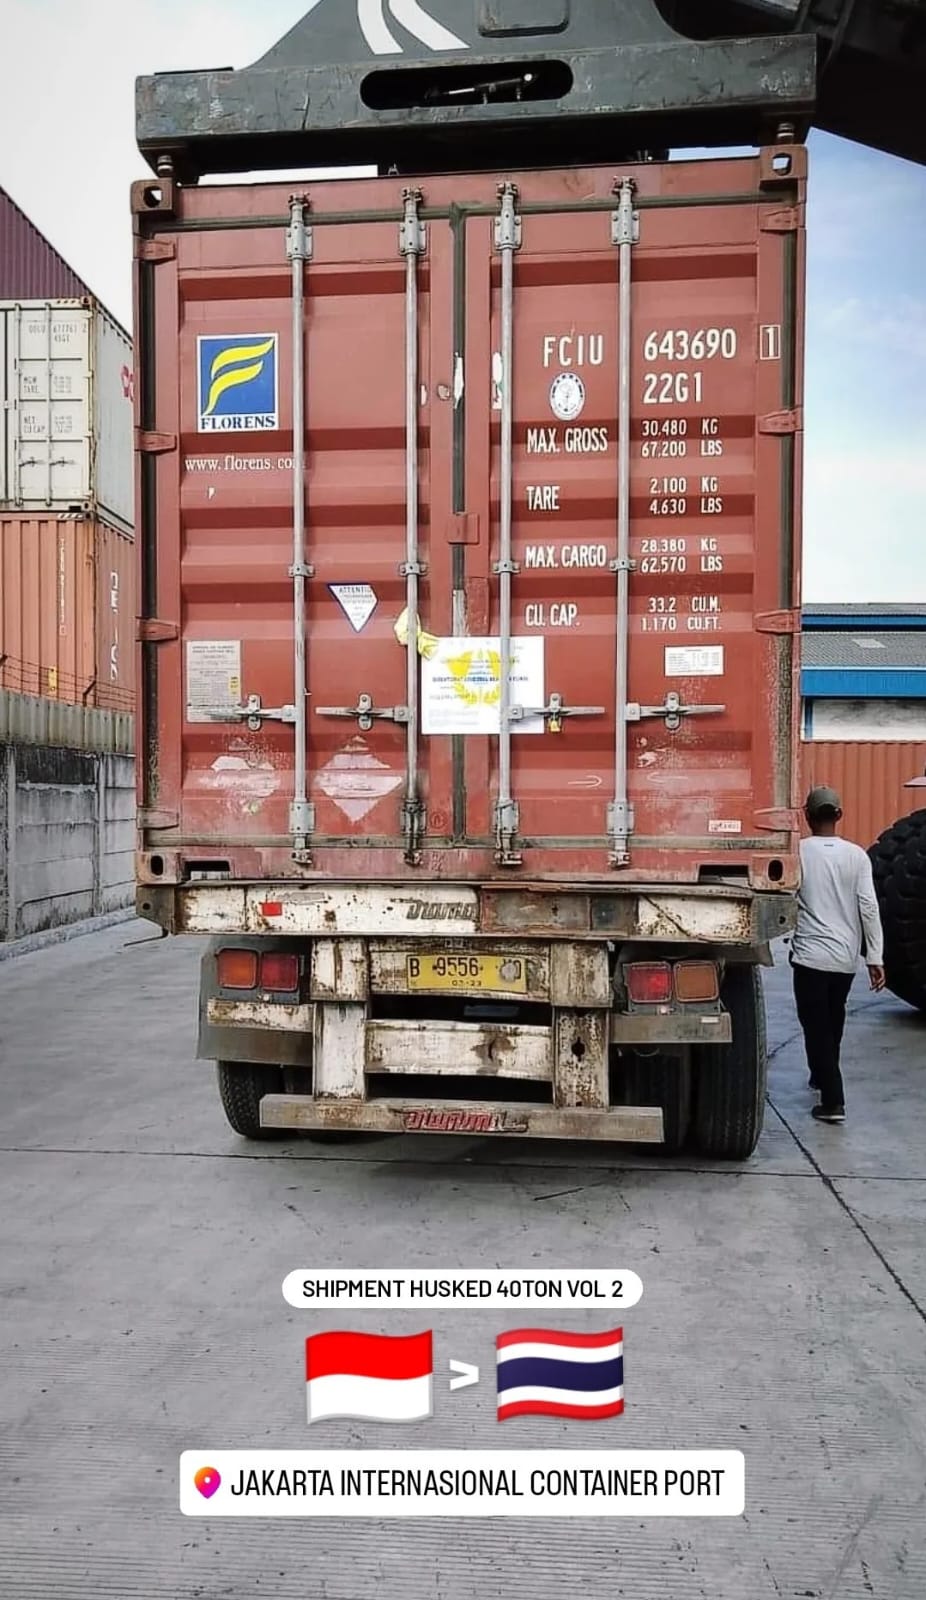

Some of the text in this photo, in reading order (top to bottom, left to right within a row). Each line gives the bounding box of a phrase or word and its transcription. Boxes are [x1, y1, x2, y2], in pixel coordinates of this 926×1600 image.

[543, 334, 604, 368] FCIU
[643, 328, 737, 361] 643690
[642, 371, 702, 404] 22G1
[200, 415, 276, 430] FLORENS
[526, 418, 719, 453] MAX. GROSS 30.480 KG
[641, 440, 723, 458] 67.200 LBS
[526, 476, 719, 511] TARE 2.100 KG
[649, 498, 723, 515] 4.630 LBS
[525, 538, 718, 569] MAX. CARGO 28.380 KG
[641, 556, 723, 573] 62.570 LBS
[525, 604, 546, 627] CU.
[550, 603, 581, 627] CAP.
[649, 597, 677, 613] 33.2
[641, 617, 677, 631] 1.170
[409, 957, 421, 977] B
[436, 957, 479, 977] 9556
